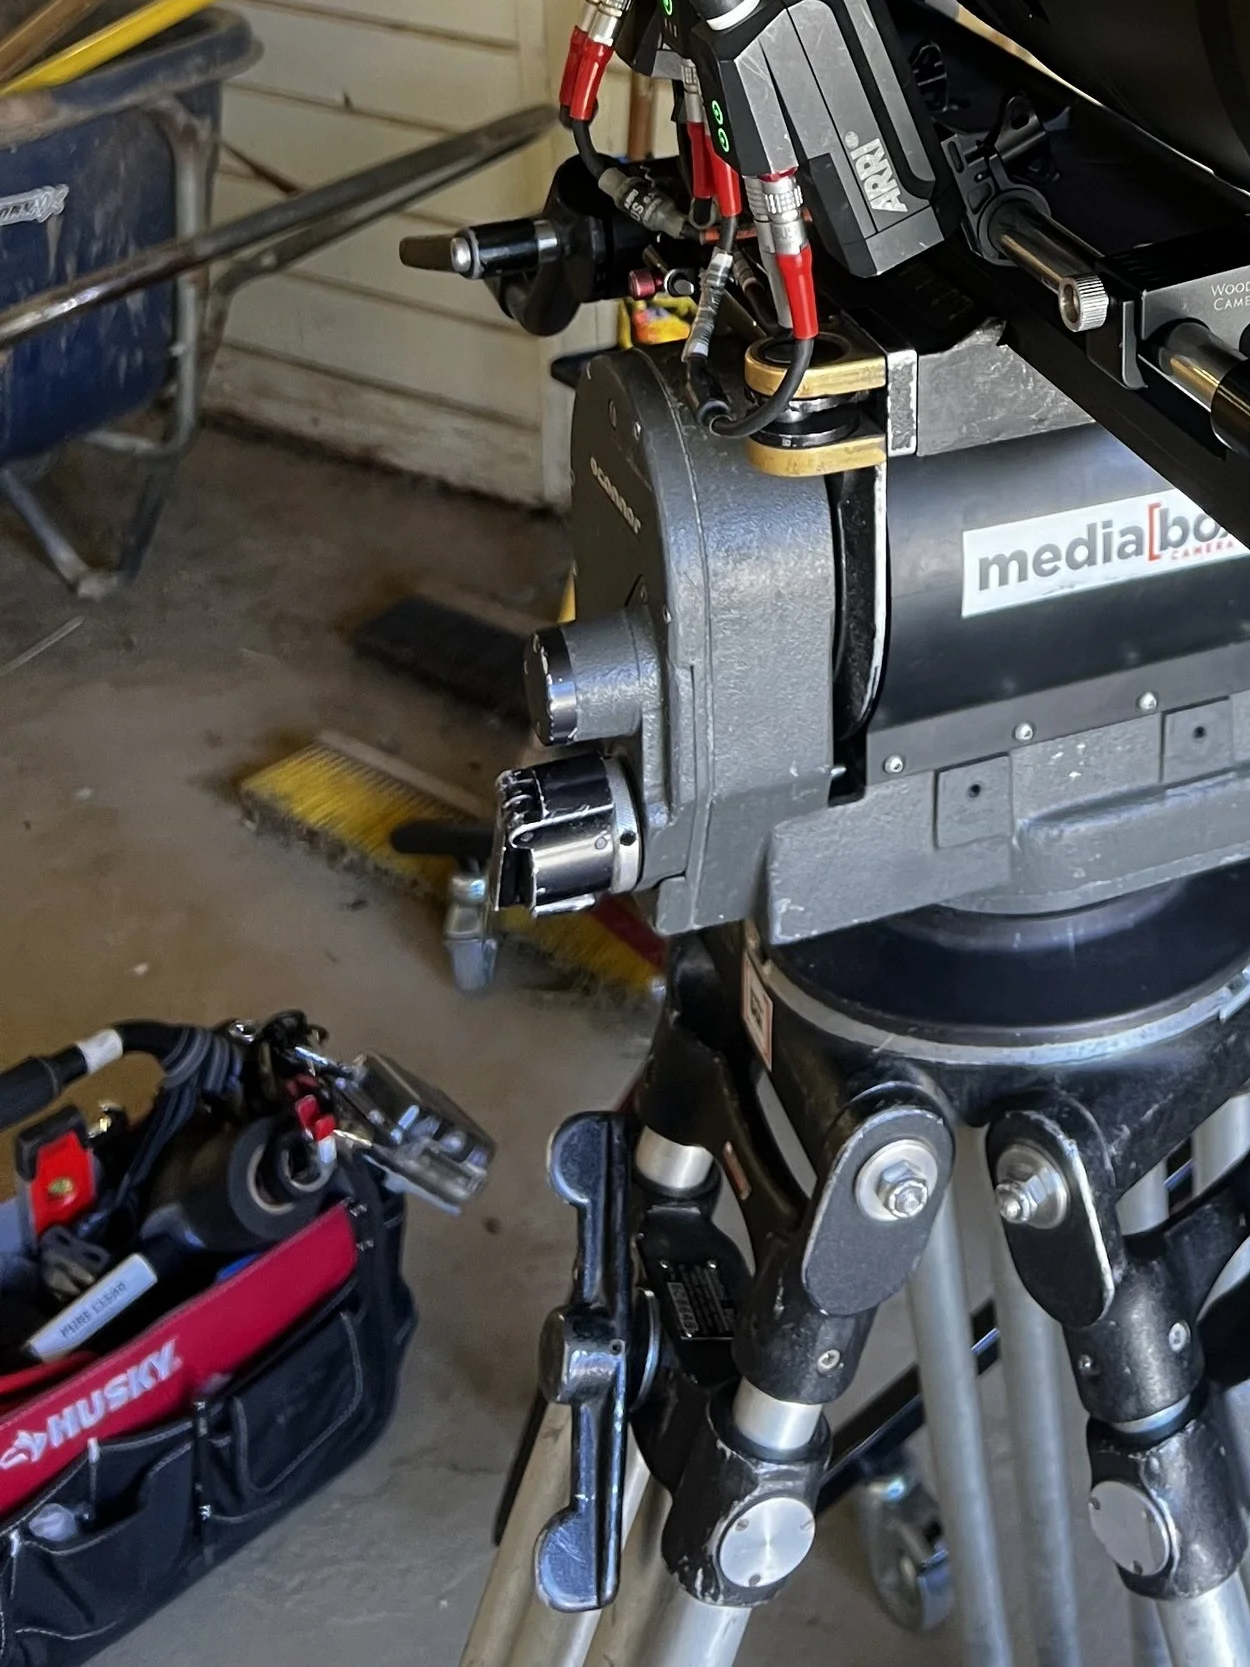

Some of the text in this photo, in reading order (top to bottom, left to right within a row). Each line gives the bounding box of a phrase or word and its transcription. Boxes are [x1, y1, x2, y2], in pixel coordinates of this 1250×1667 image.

[850, 137, 908, 212] ARRI
[1171, 539, 1235, 561] CAMERA
[47, 1336, 176, 1448] HUSKY
